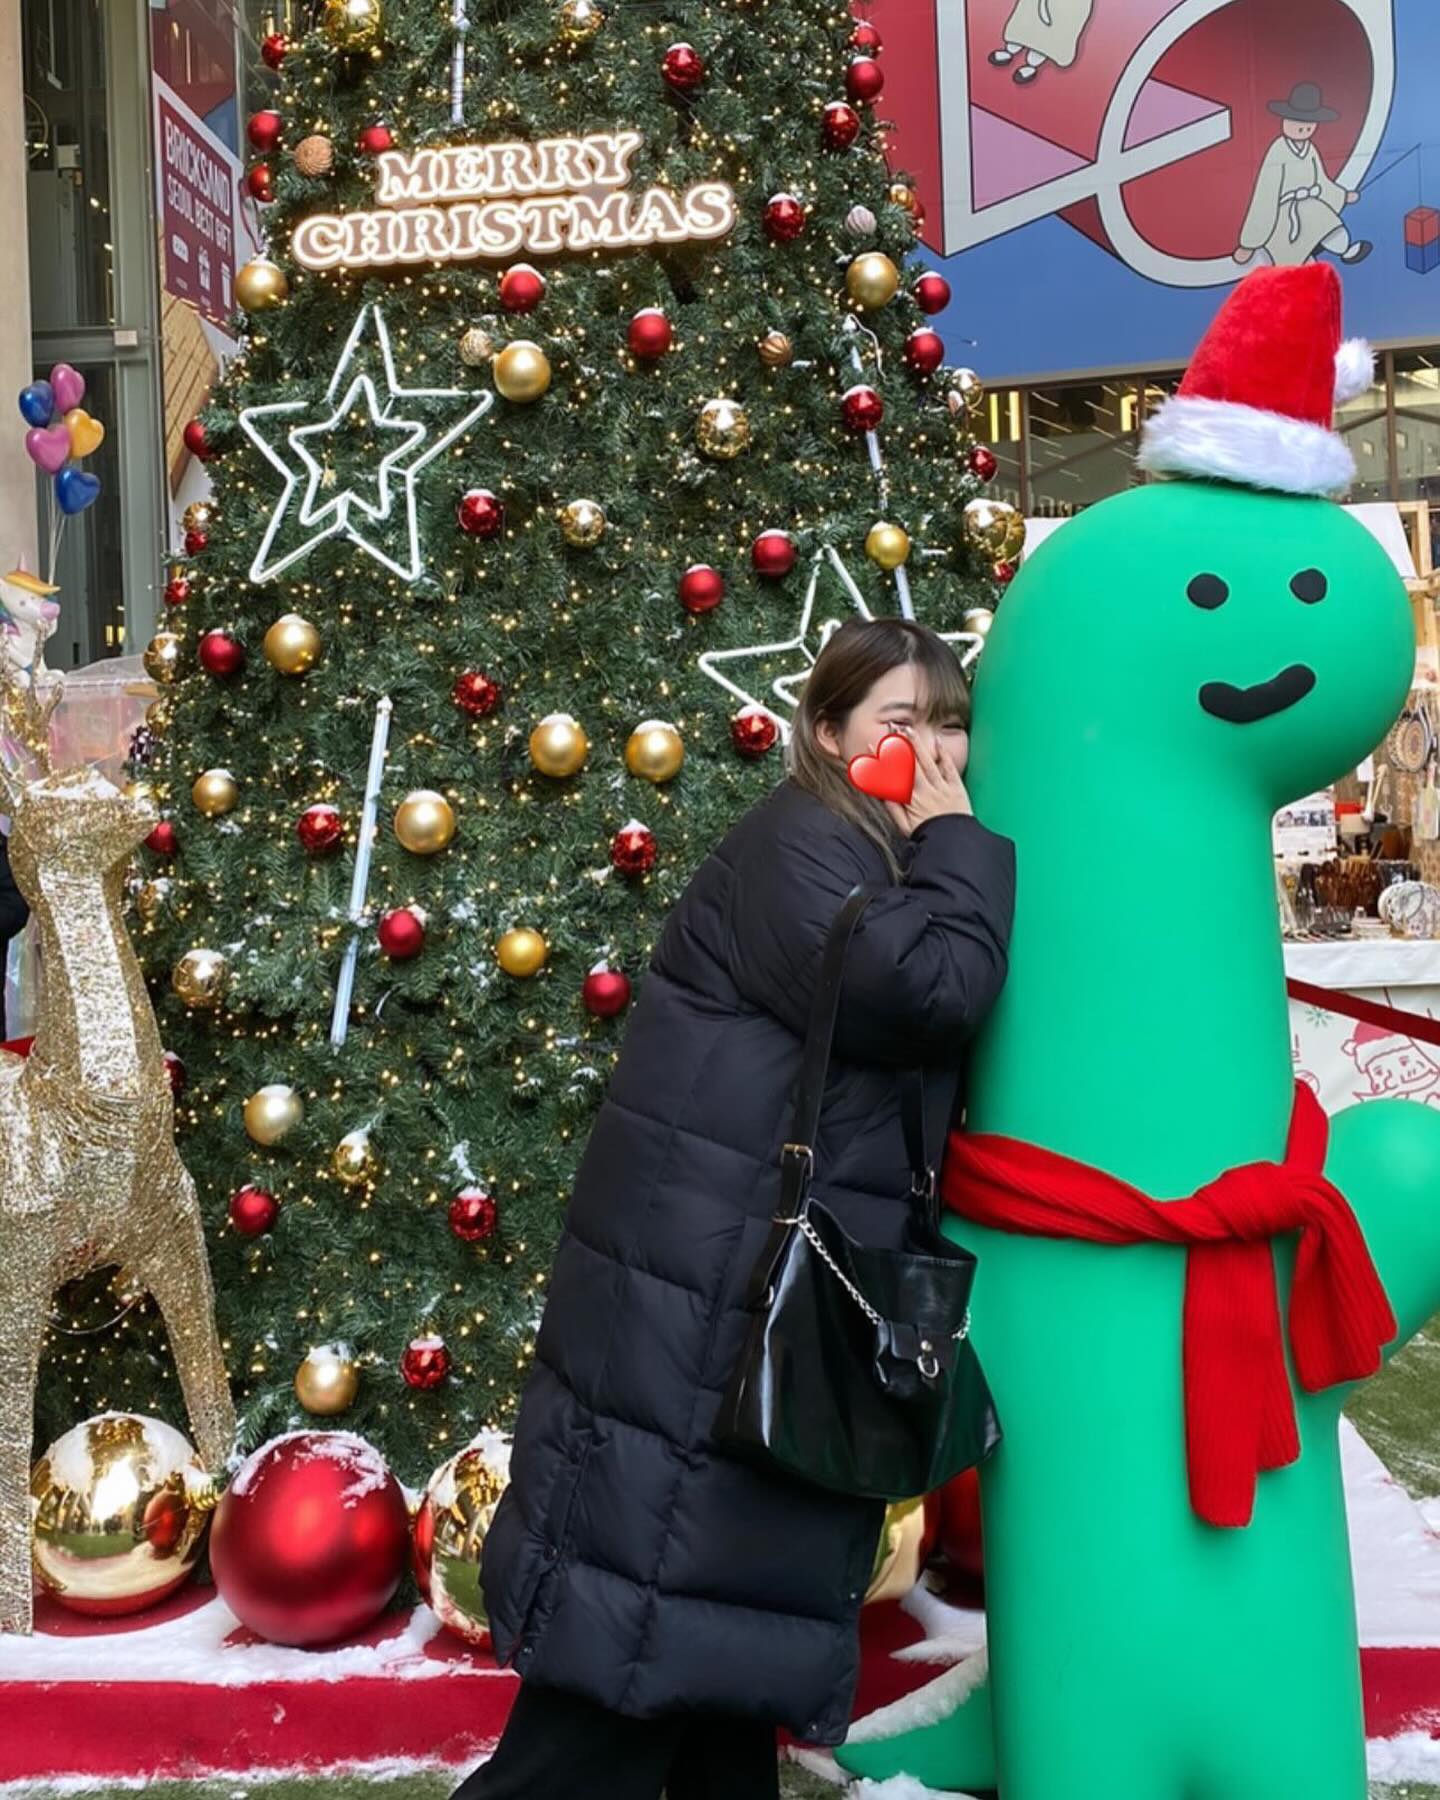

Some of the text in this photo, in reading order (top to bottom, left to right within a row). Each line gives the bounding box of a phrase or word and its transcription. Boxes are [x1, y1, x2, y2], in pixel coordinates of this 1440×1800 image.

[165, 115, 230, 217] BRICKSAND
[377, 131, 641, 203] MERRY
[167, 173, 232, 257] SEOUL BEST GIFT
[292, 183, 736, 269] CHRISTMAS
